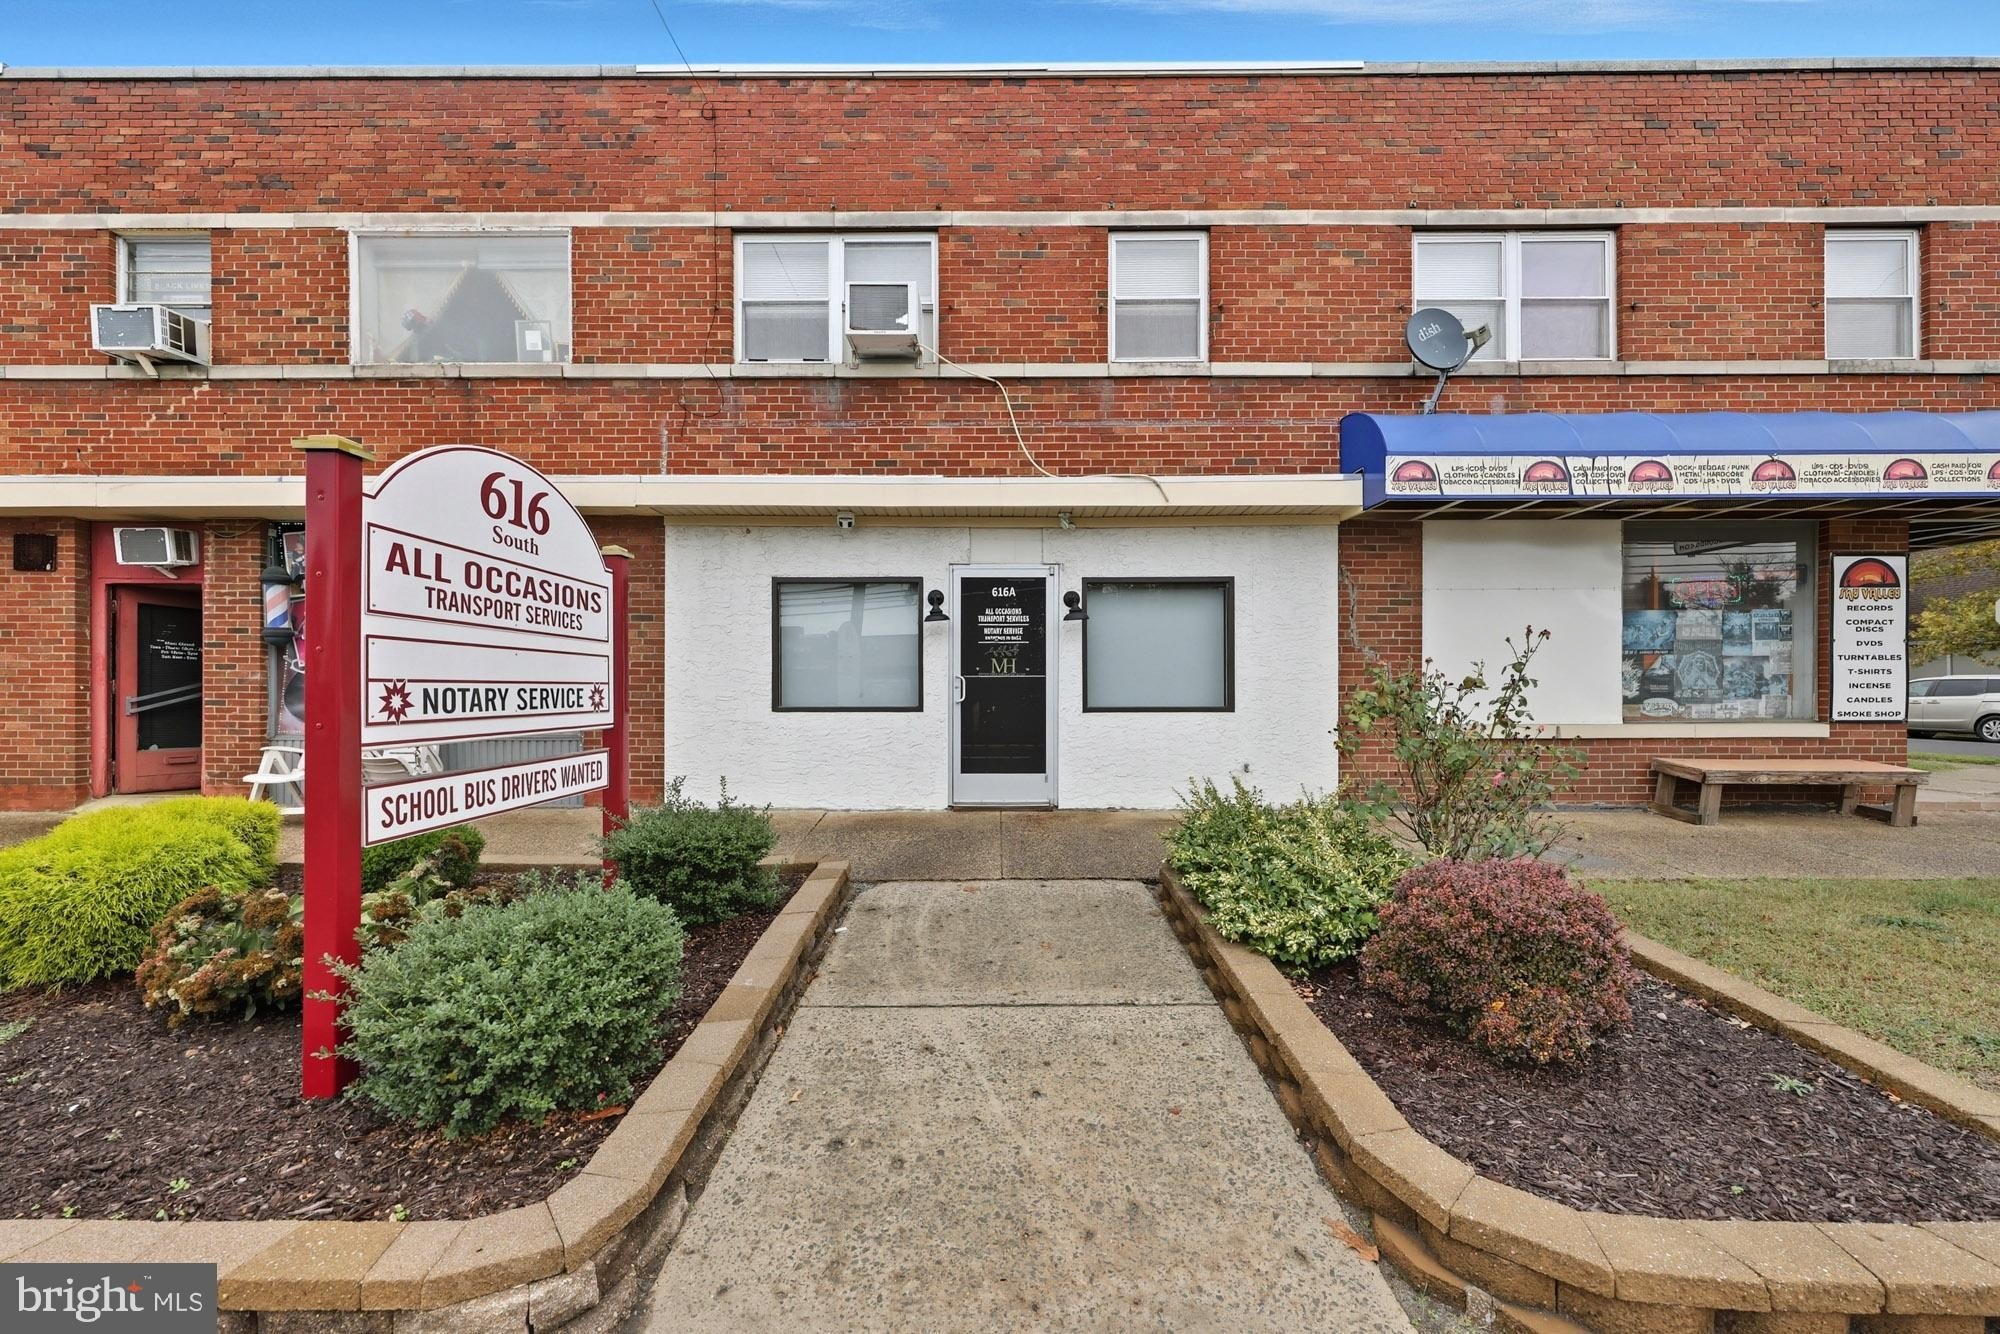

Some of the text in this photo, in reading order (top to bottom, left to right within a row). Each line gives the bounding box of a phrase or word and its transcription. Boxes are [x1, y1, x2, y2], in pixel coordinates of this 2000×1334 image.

[1418, 322, 1442, 342] dish
[480, 472, 550, 536] 616
[492, 525, 540, 556] South
[384, 542, 602, 614] ALL OCCASIONS
[992, 586, 1016, 597] 616A
[424, 586, 583, 631] TRANSPORT SERVICES
[991, 658, 1016, 674] MH
[422, 687, 584, 714] NOTARY SERVICE
[381, 760, 602, 828] SCHOOL BUS DRIVERS WANTED
